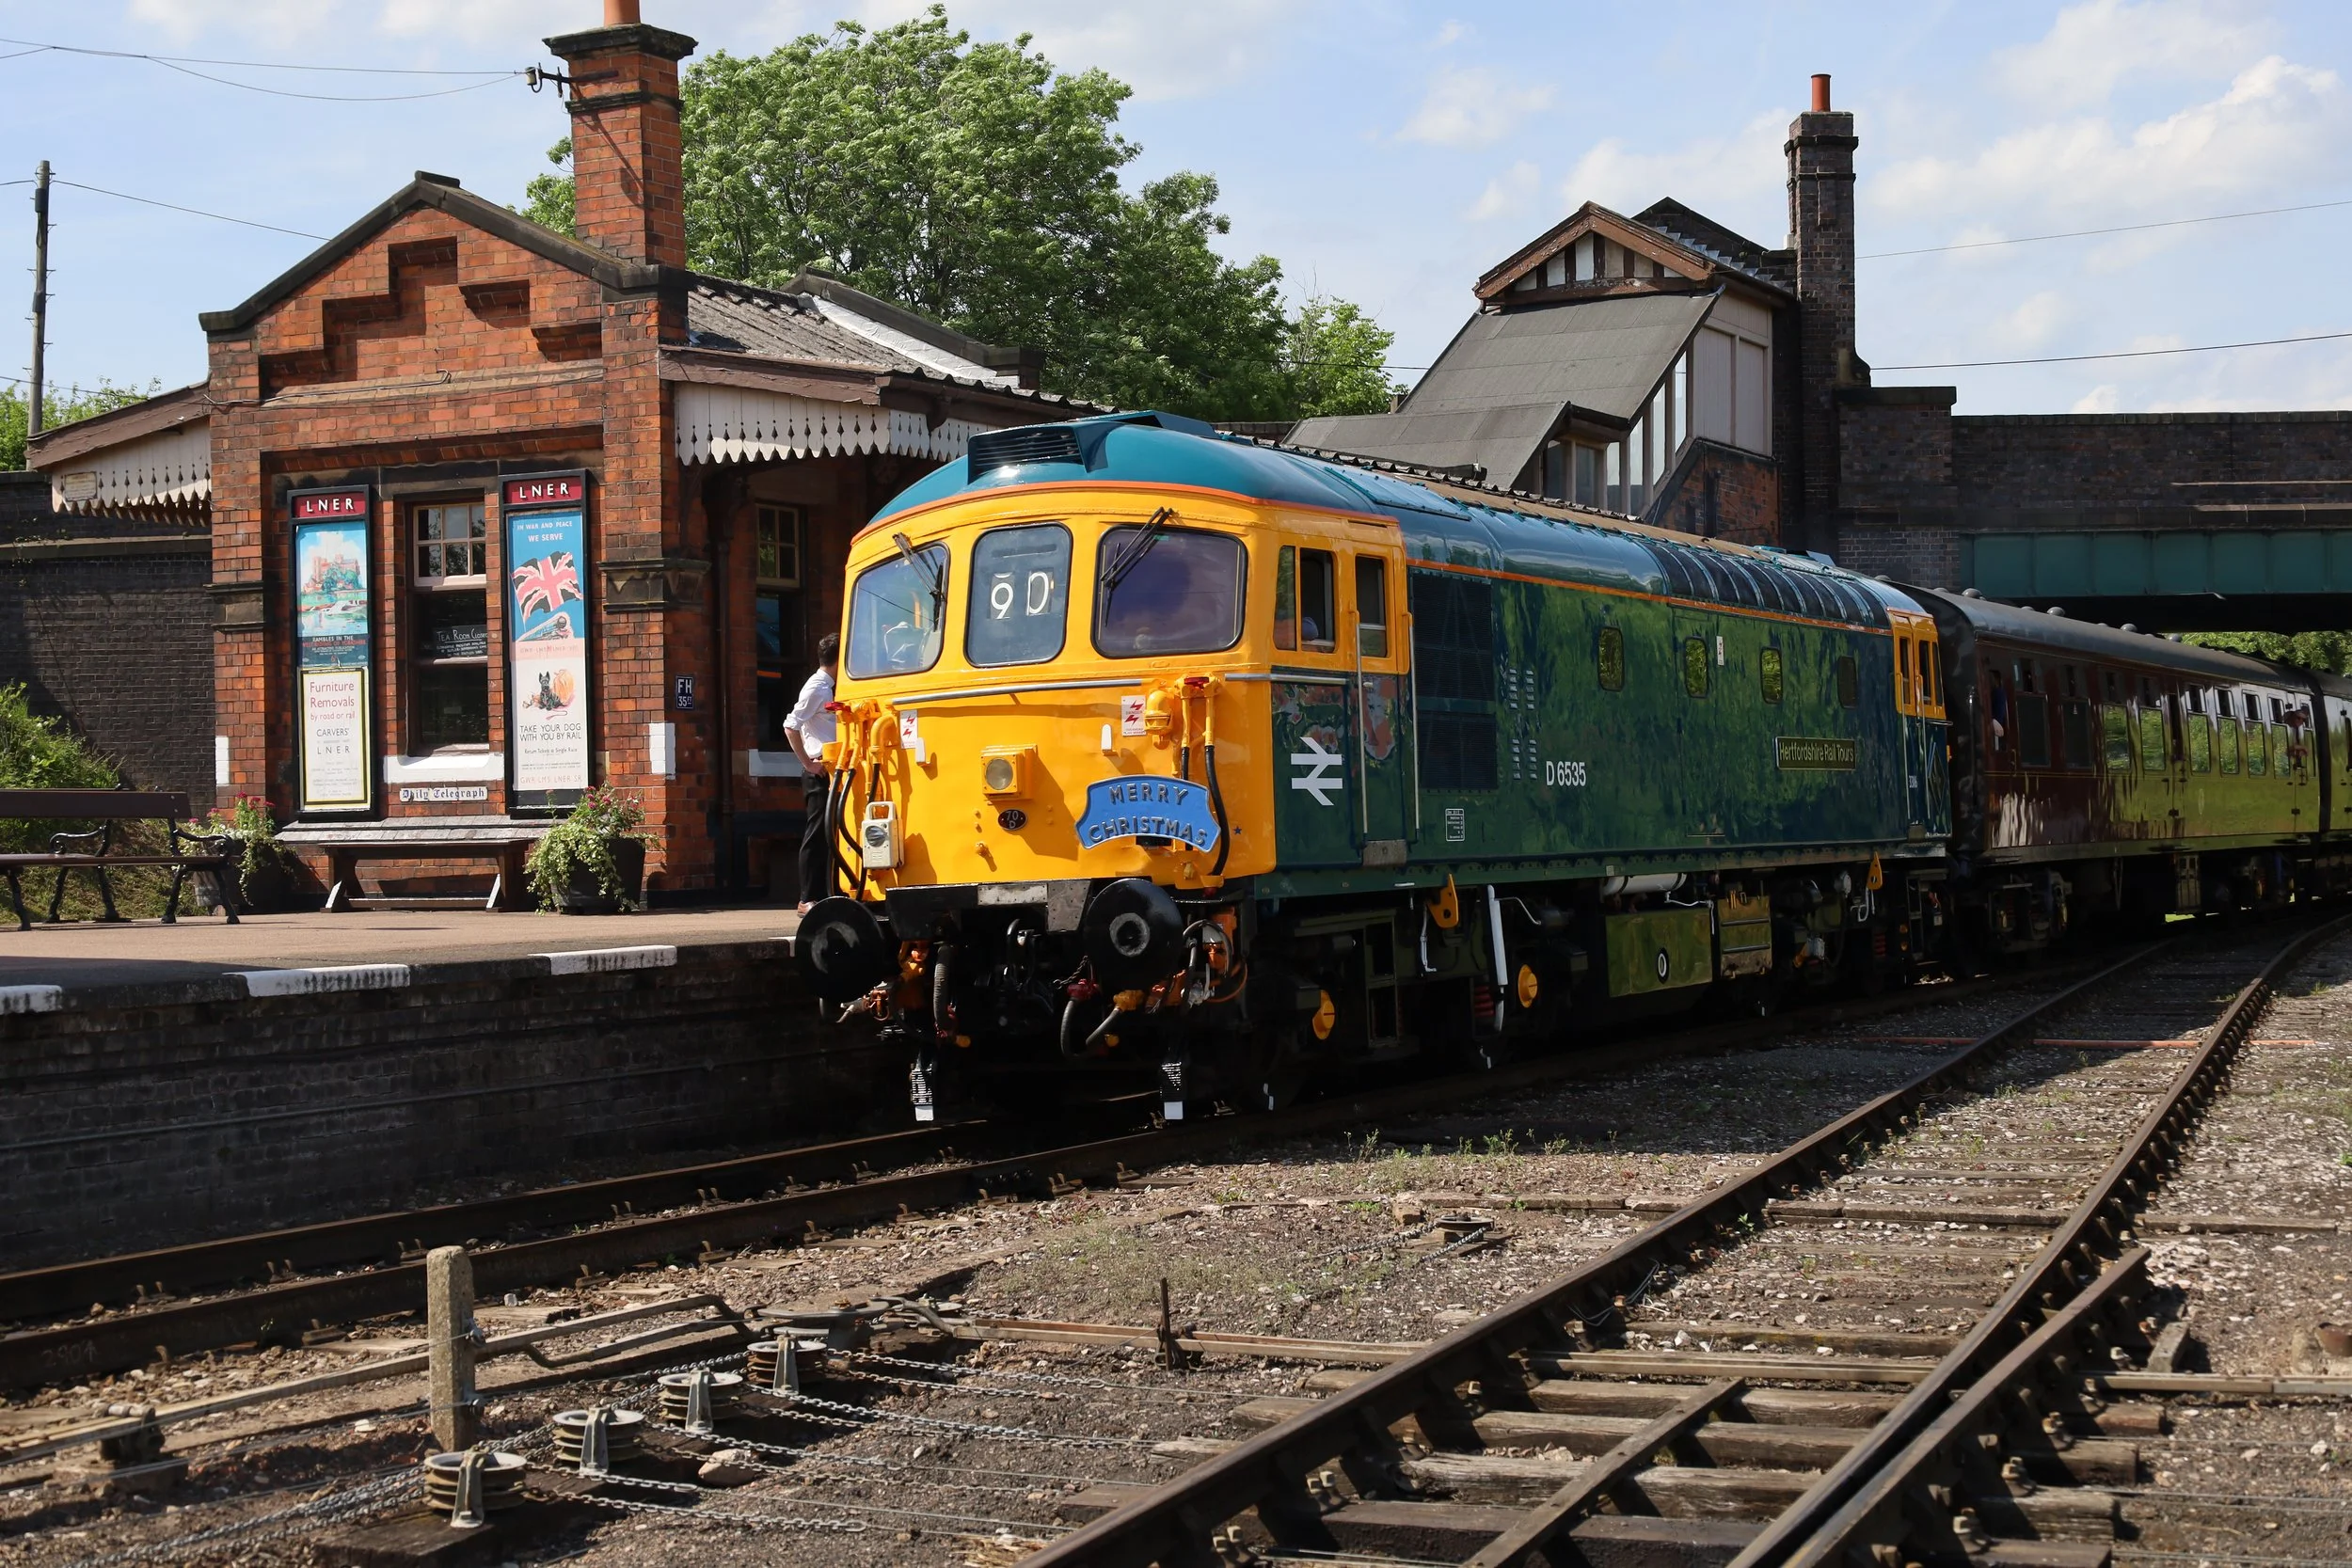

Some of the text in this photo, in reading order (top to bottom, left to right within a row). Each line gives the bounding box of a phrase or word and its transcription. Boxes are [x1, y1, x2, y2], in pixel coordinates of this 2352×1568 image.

[520, 483, 568, 498] LNER
[307, 498, 353, 512] LNER
[310, 682, 354, 692] Furniture
[678, 679, 692, 694] FH
[310, 696, 354, 708] Removals
[310, 713, 317, 721] by
[317, 746, 350, 755] LNER
[1779, 742, 1854, 762] Hertfordshire Rail Tours
[434, 788, 484, 801] Telegraph
[1109, 783, 1188, 805] MERRY
[1006, 810, 1019, 820] 70
[1009, 820, 1016, 828] D
[1089, 816, 1207, 844] CHRISTMAS
